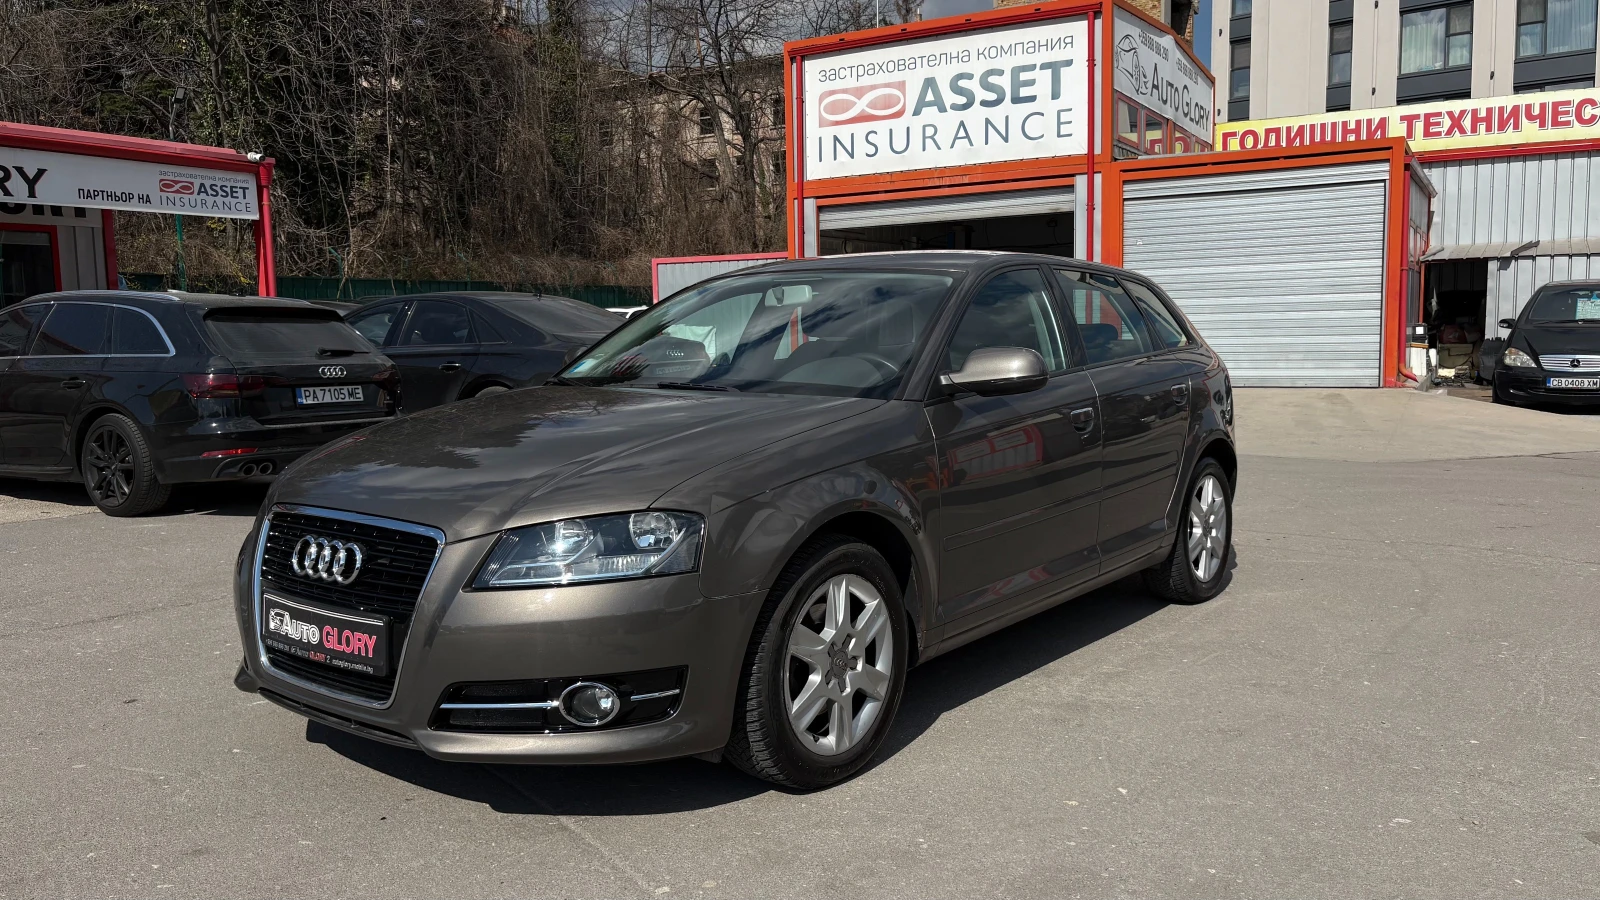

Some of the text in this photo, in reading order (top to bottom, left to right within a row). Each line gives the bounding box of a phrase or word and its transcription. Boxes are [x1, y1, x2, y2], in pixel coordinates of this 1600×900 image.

[818, 35, 1074, 83] застрахователна компания
[911, 58, 1074, 117] ASSET
[1150, 62, 1180, 113] AUTO
[1181, 84, 1210, 132] GLORY
[818, 107, 1073, 163] INSURANCE
[1221, 115, 1391, 151] ГОДИШНИ
[1399, 97, 1600, 141] ТЕХНИЧЕС
[77, 187, 152, 205] ПАРТНЬОР НА
[159, 195, 251, 213] INSURANCE
[196, 182, 250, 200] ASSET
[281, 611, 377, 658] AUTO GLORY
